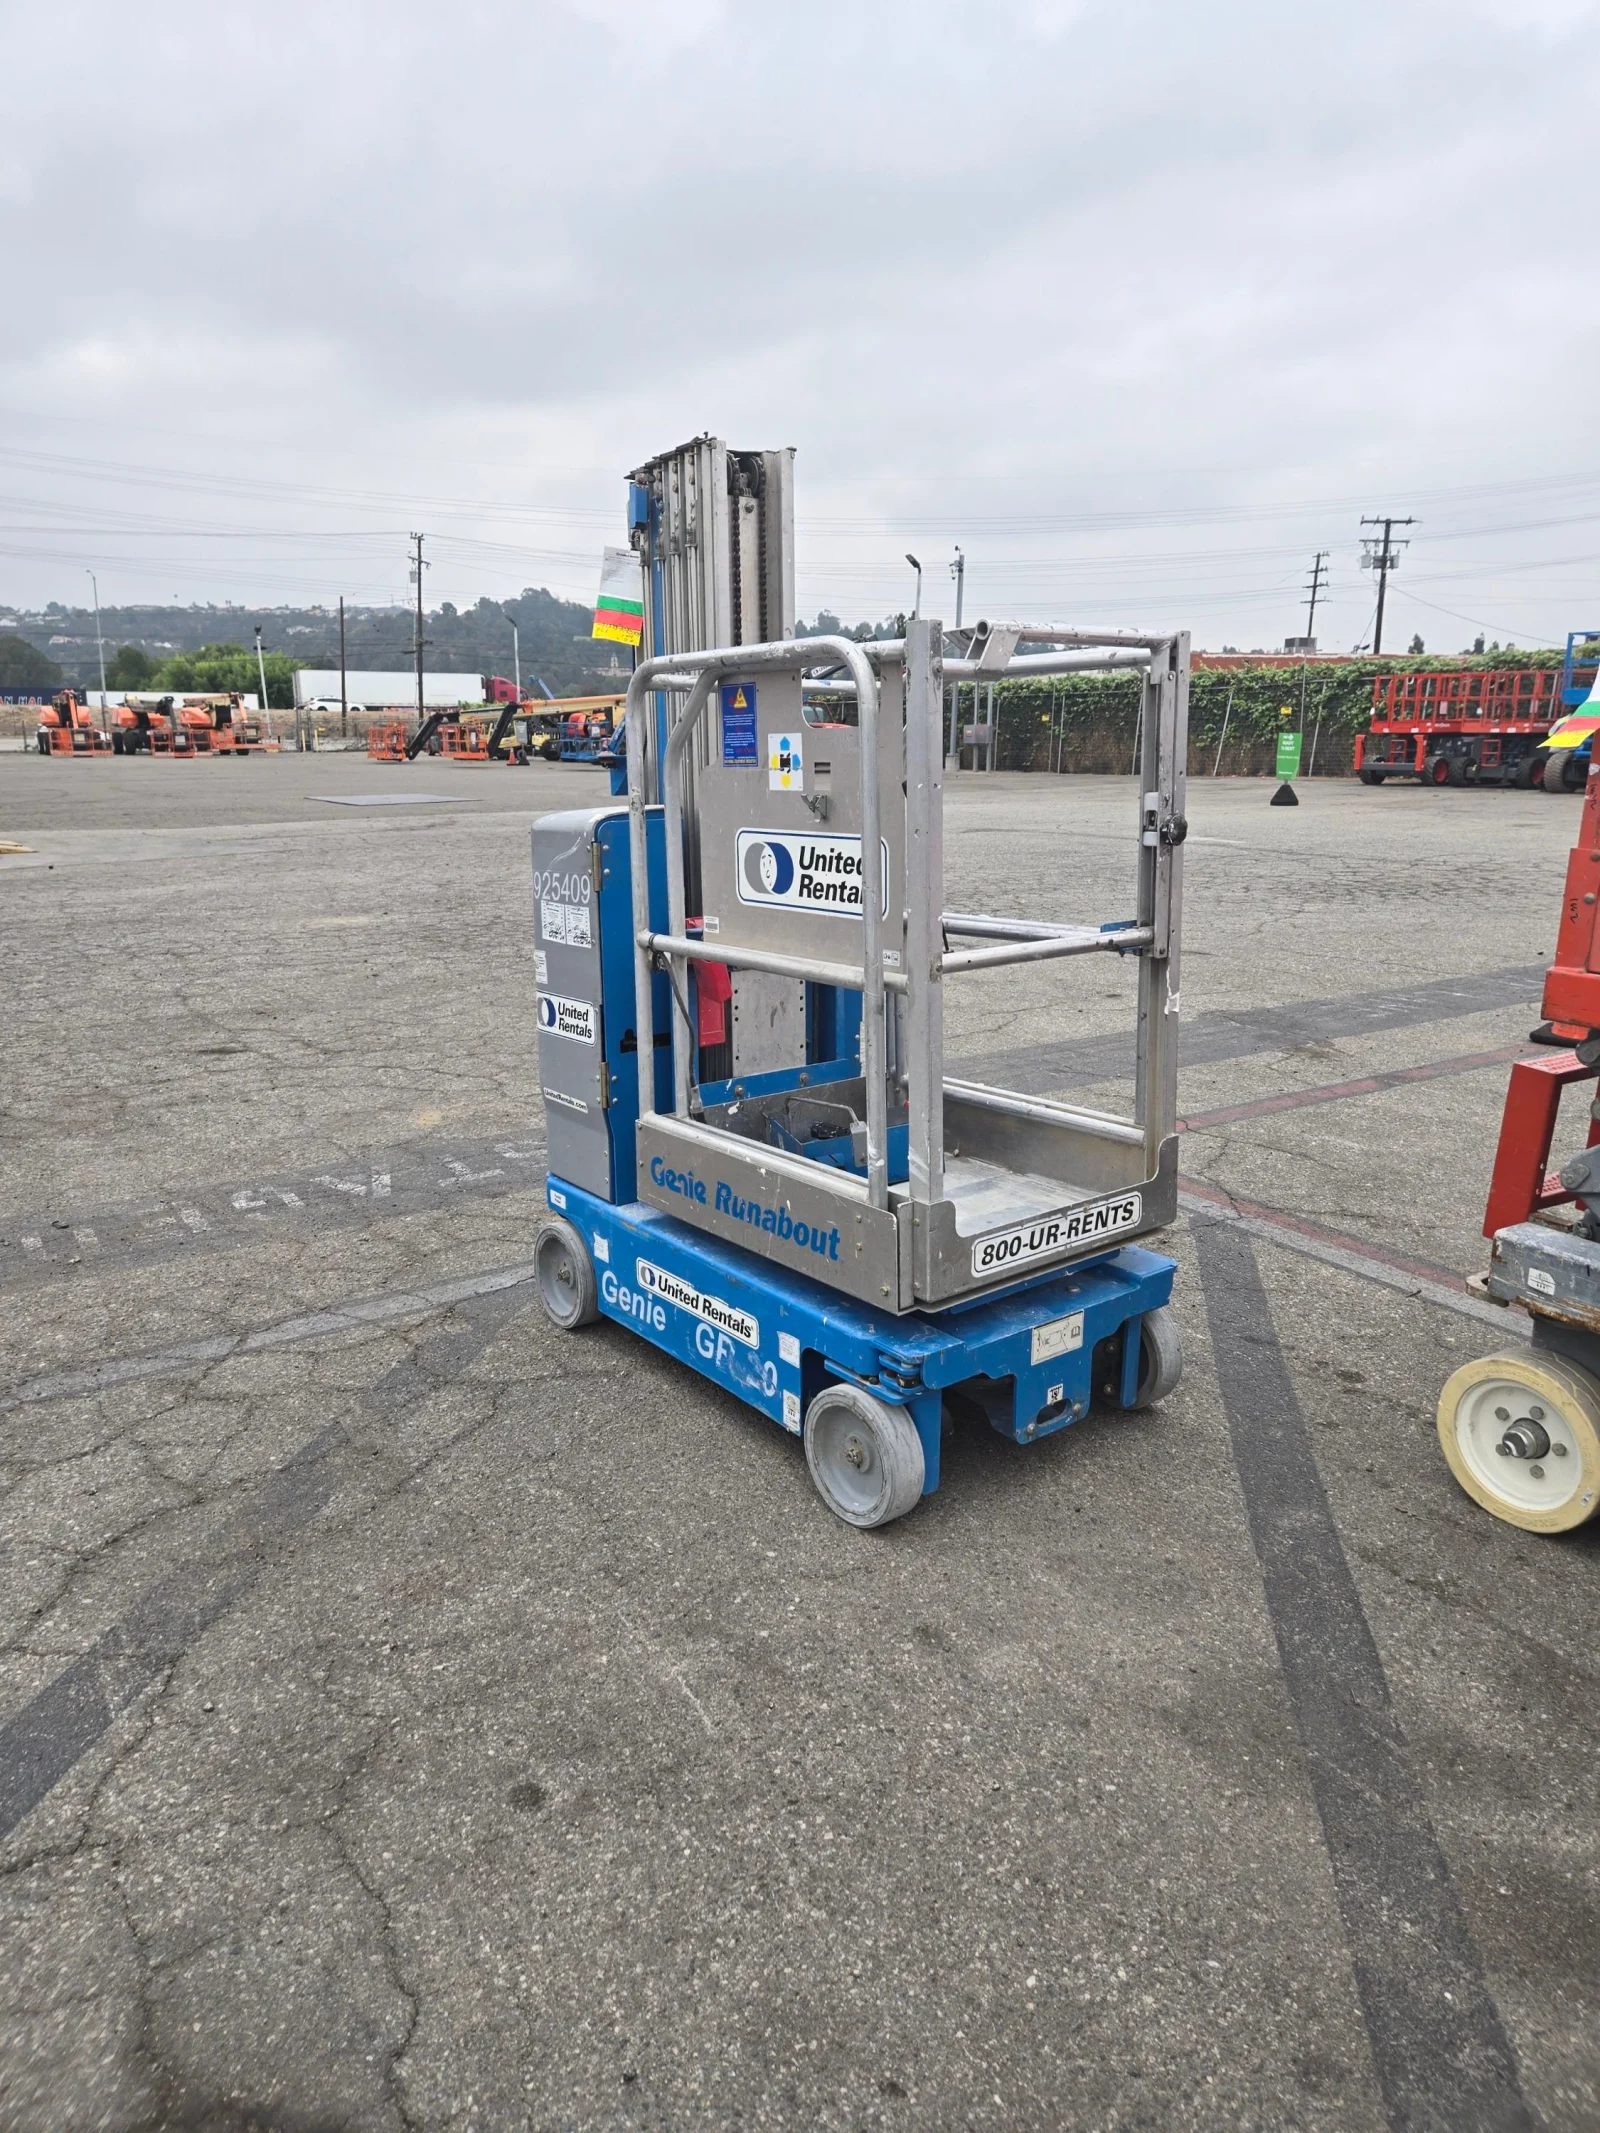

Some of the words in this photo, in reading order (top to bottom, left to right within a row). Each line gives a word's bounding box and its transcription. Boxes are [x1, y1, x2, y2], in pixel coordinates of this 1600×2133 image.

[0, 695, 13, 705] N
[533, 871, 591, 904] 925409
[799, 873, 862, 905] Renta
[558, 1001, 589, 1022] United
[558, 1016, 592, 1039] Rentals
[650, 1156, 707, 1205] Genie
[714, 1180, 841, 1261] Runabout
[981, 1201, 1135, 1266] 800-UR-RENTS
[601, 1270, 667, 1332] Genie
[657, 1274, 700, 1310] United
[702, 1297, 752, 1339] Rentals
